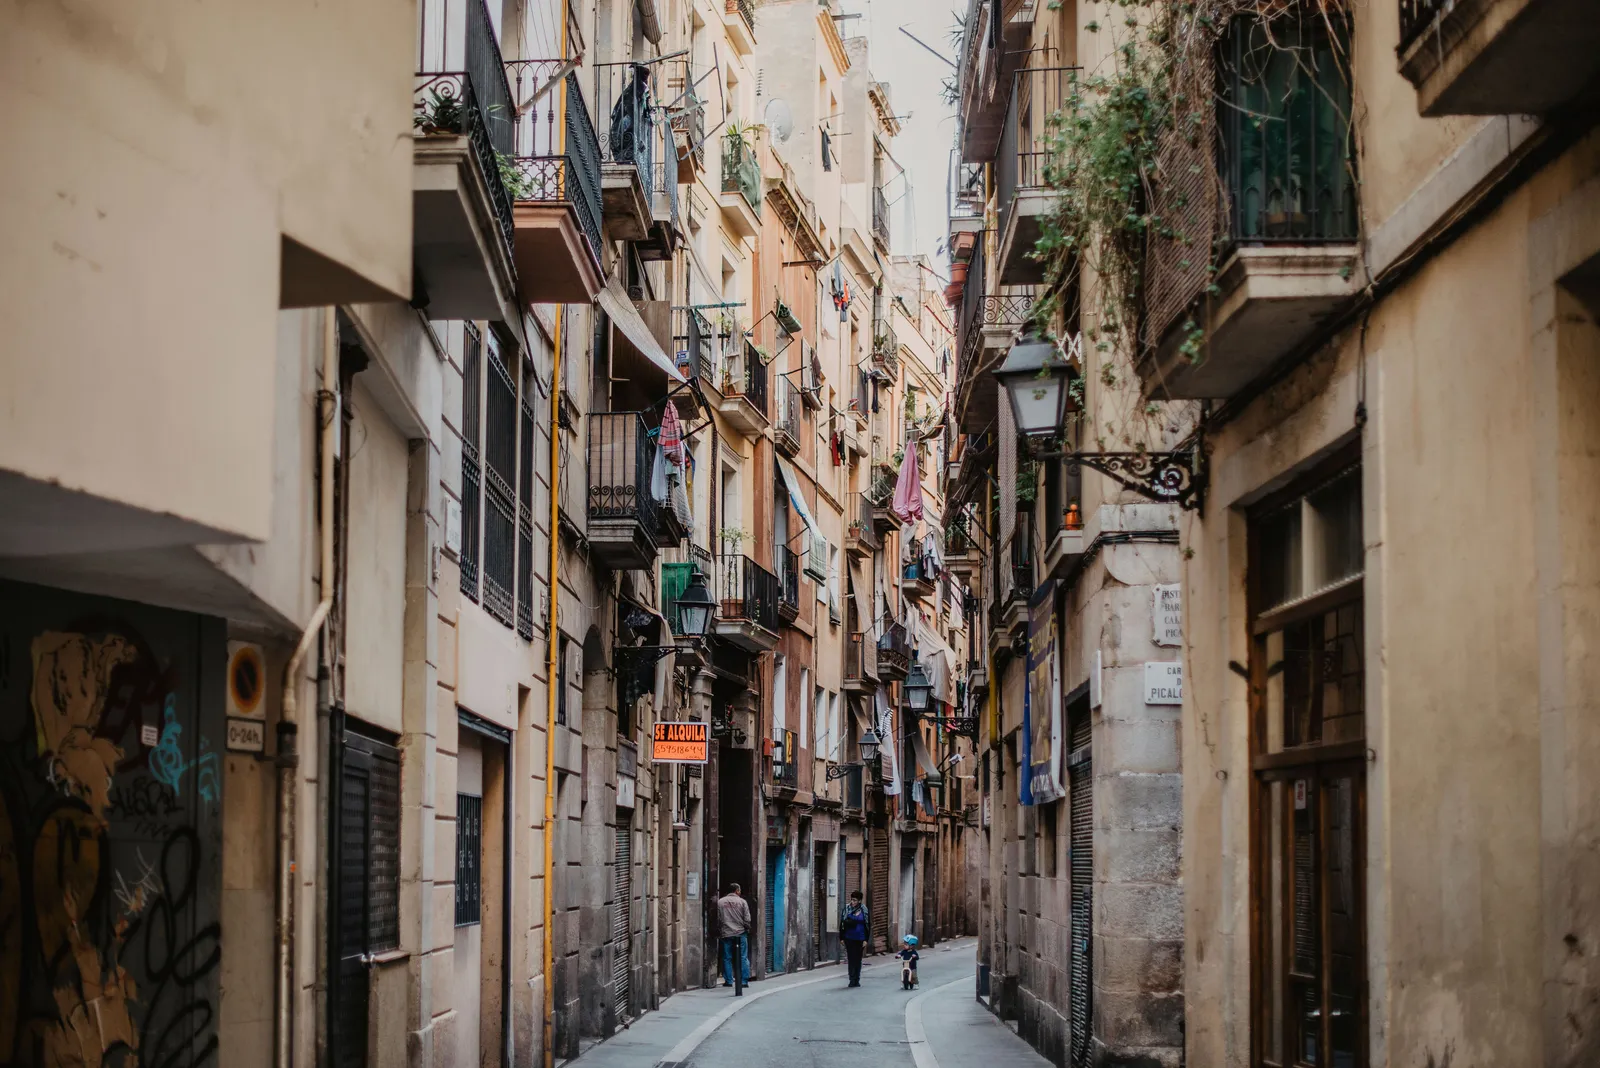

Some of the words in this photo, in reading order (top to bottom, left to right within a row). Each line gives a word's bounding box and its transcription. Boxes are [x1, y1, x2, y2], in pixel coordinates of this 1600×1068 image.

[1162, 591, 1182, 599] DIST
[1165, 603, 1182, 611] BAR
[655, 724, 664, 740] SE
[667, 724, 705, 741] ALQUILA
